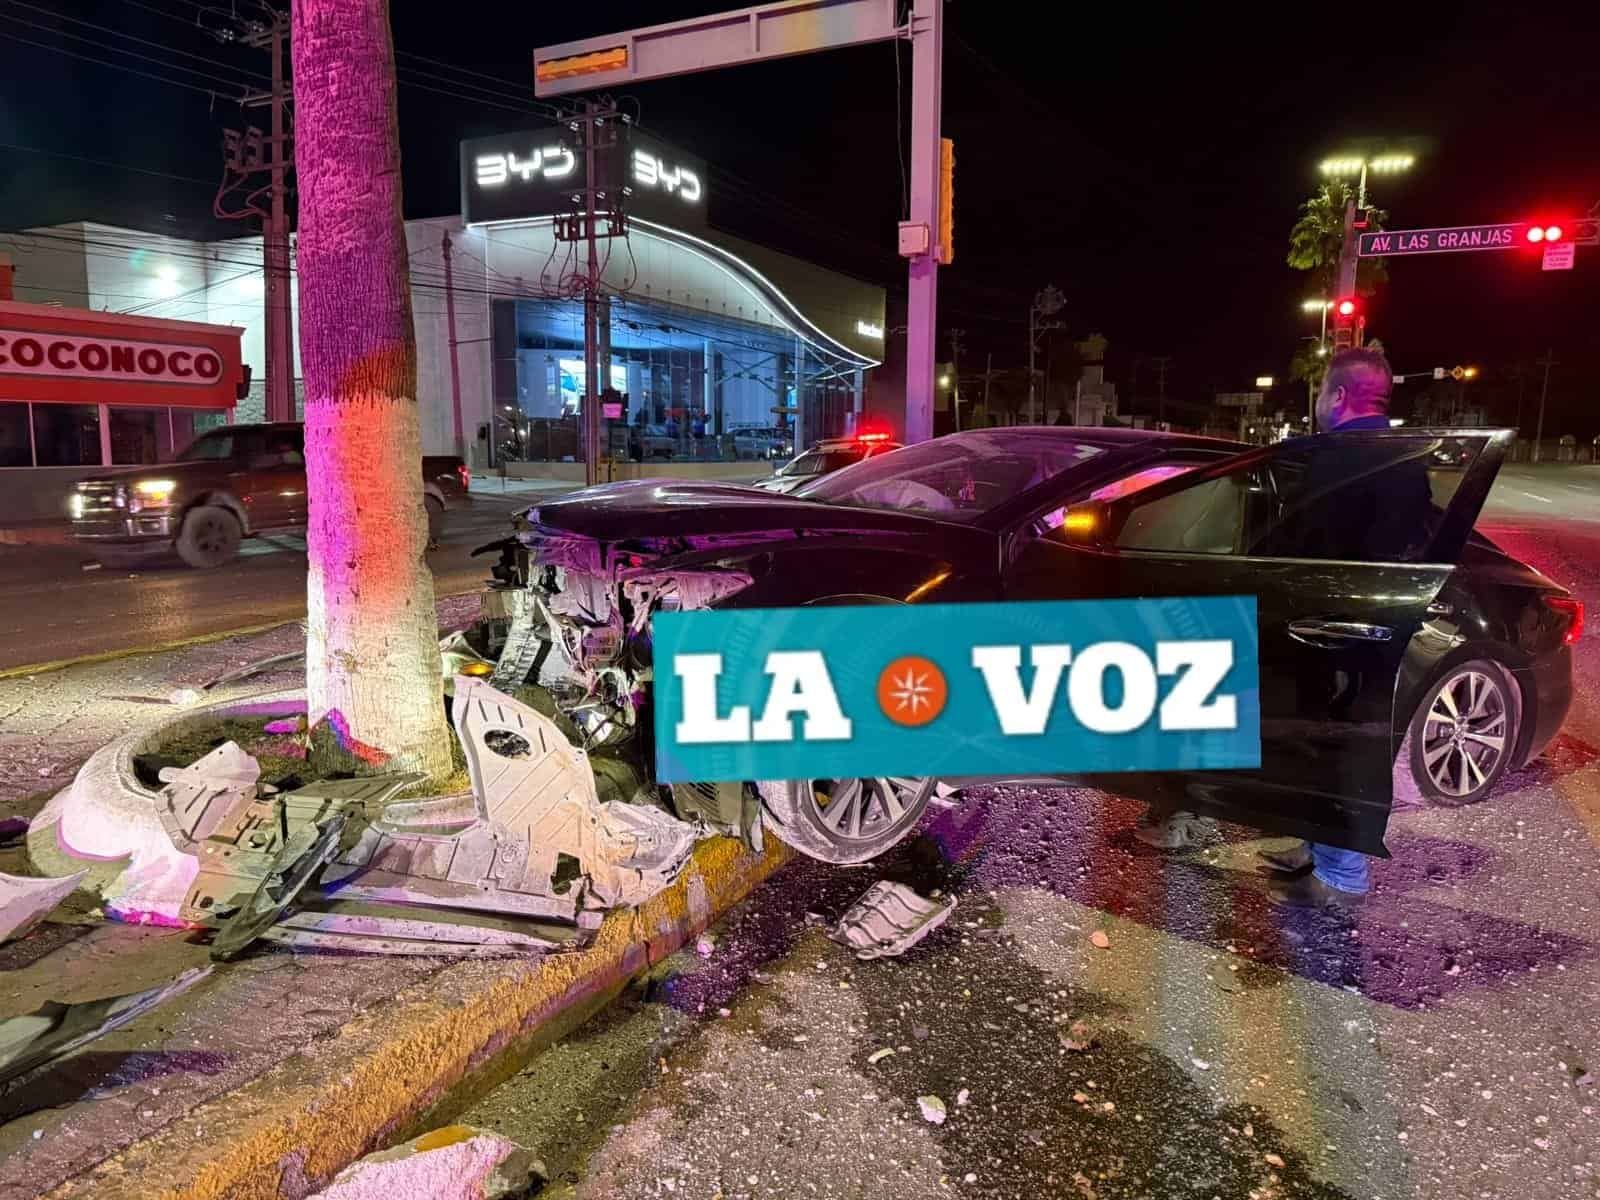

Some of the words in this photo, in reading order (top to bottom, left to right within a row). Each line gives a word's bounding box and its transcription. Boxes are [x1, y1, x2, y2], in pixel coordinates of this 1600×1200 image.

[477, 147, 575, 185] BYD
[633, 150, 701, 201] BYD
[1371, 236, 1391, 251] AV.
[1397, 234, 1429, 250] LAS
[1437, 229, 1513, 247] GRANJAS
[0, 336, 220, 378] OCONOCO
